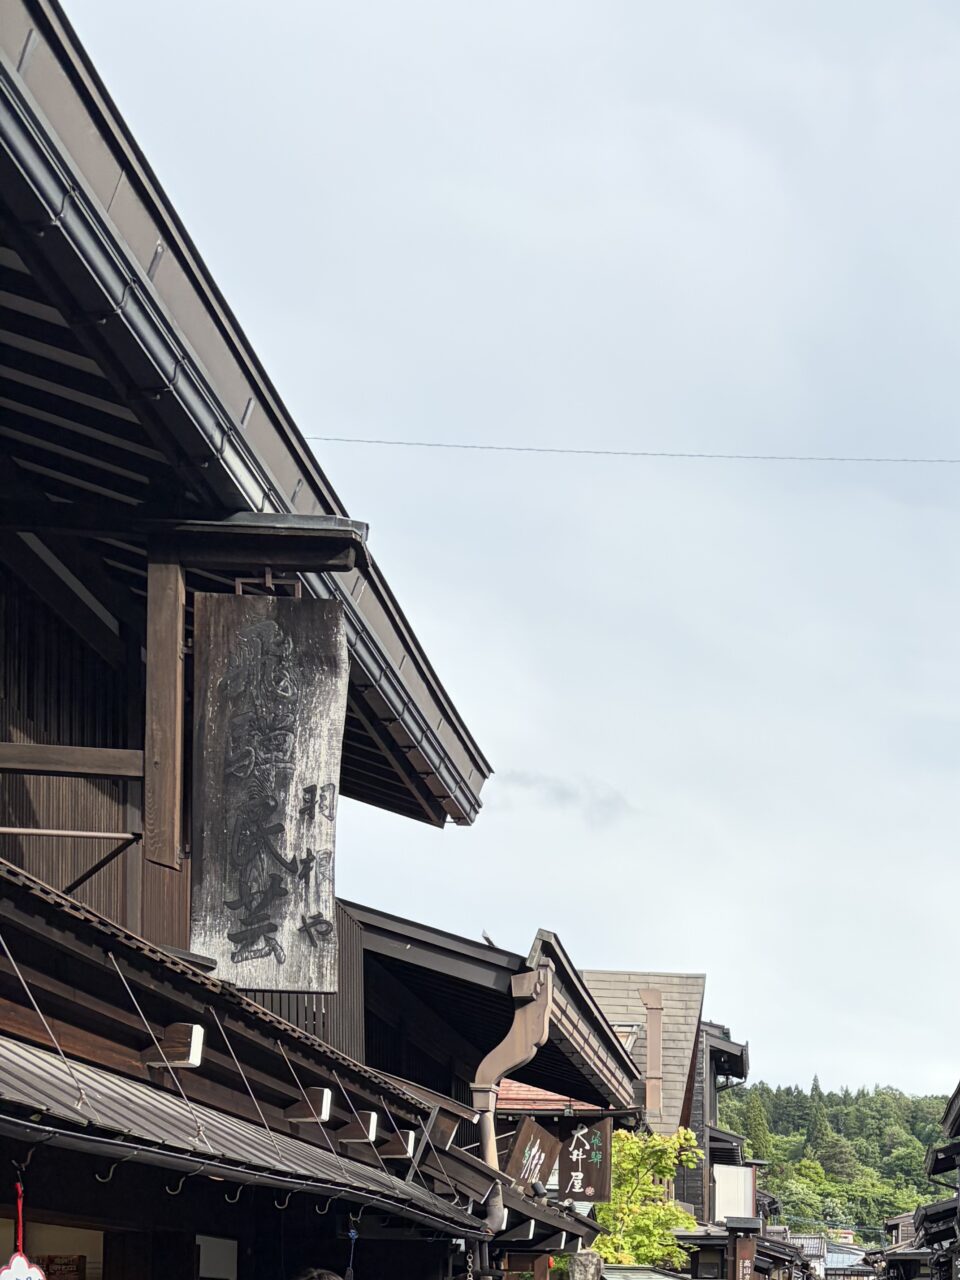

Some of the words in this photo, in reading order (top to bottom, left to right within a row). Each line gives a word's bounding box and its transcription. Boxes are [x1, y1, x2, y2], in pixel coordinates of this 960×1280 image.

[298, 783, 336, 949] 羽根や
[565, 1123, 591, 1194] 大井屋
